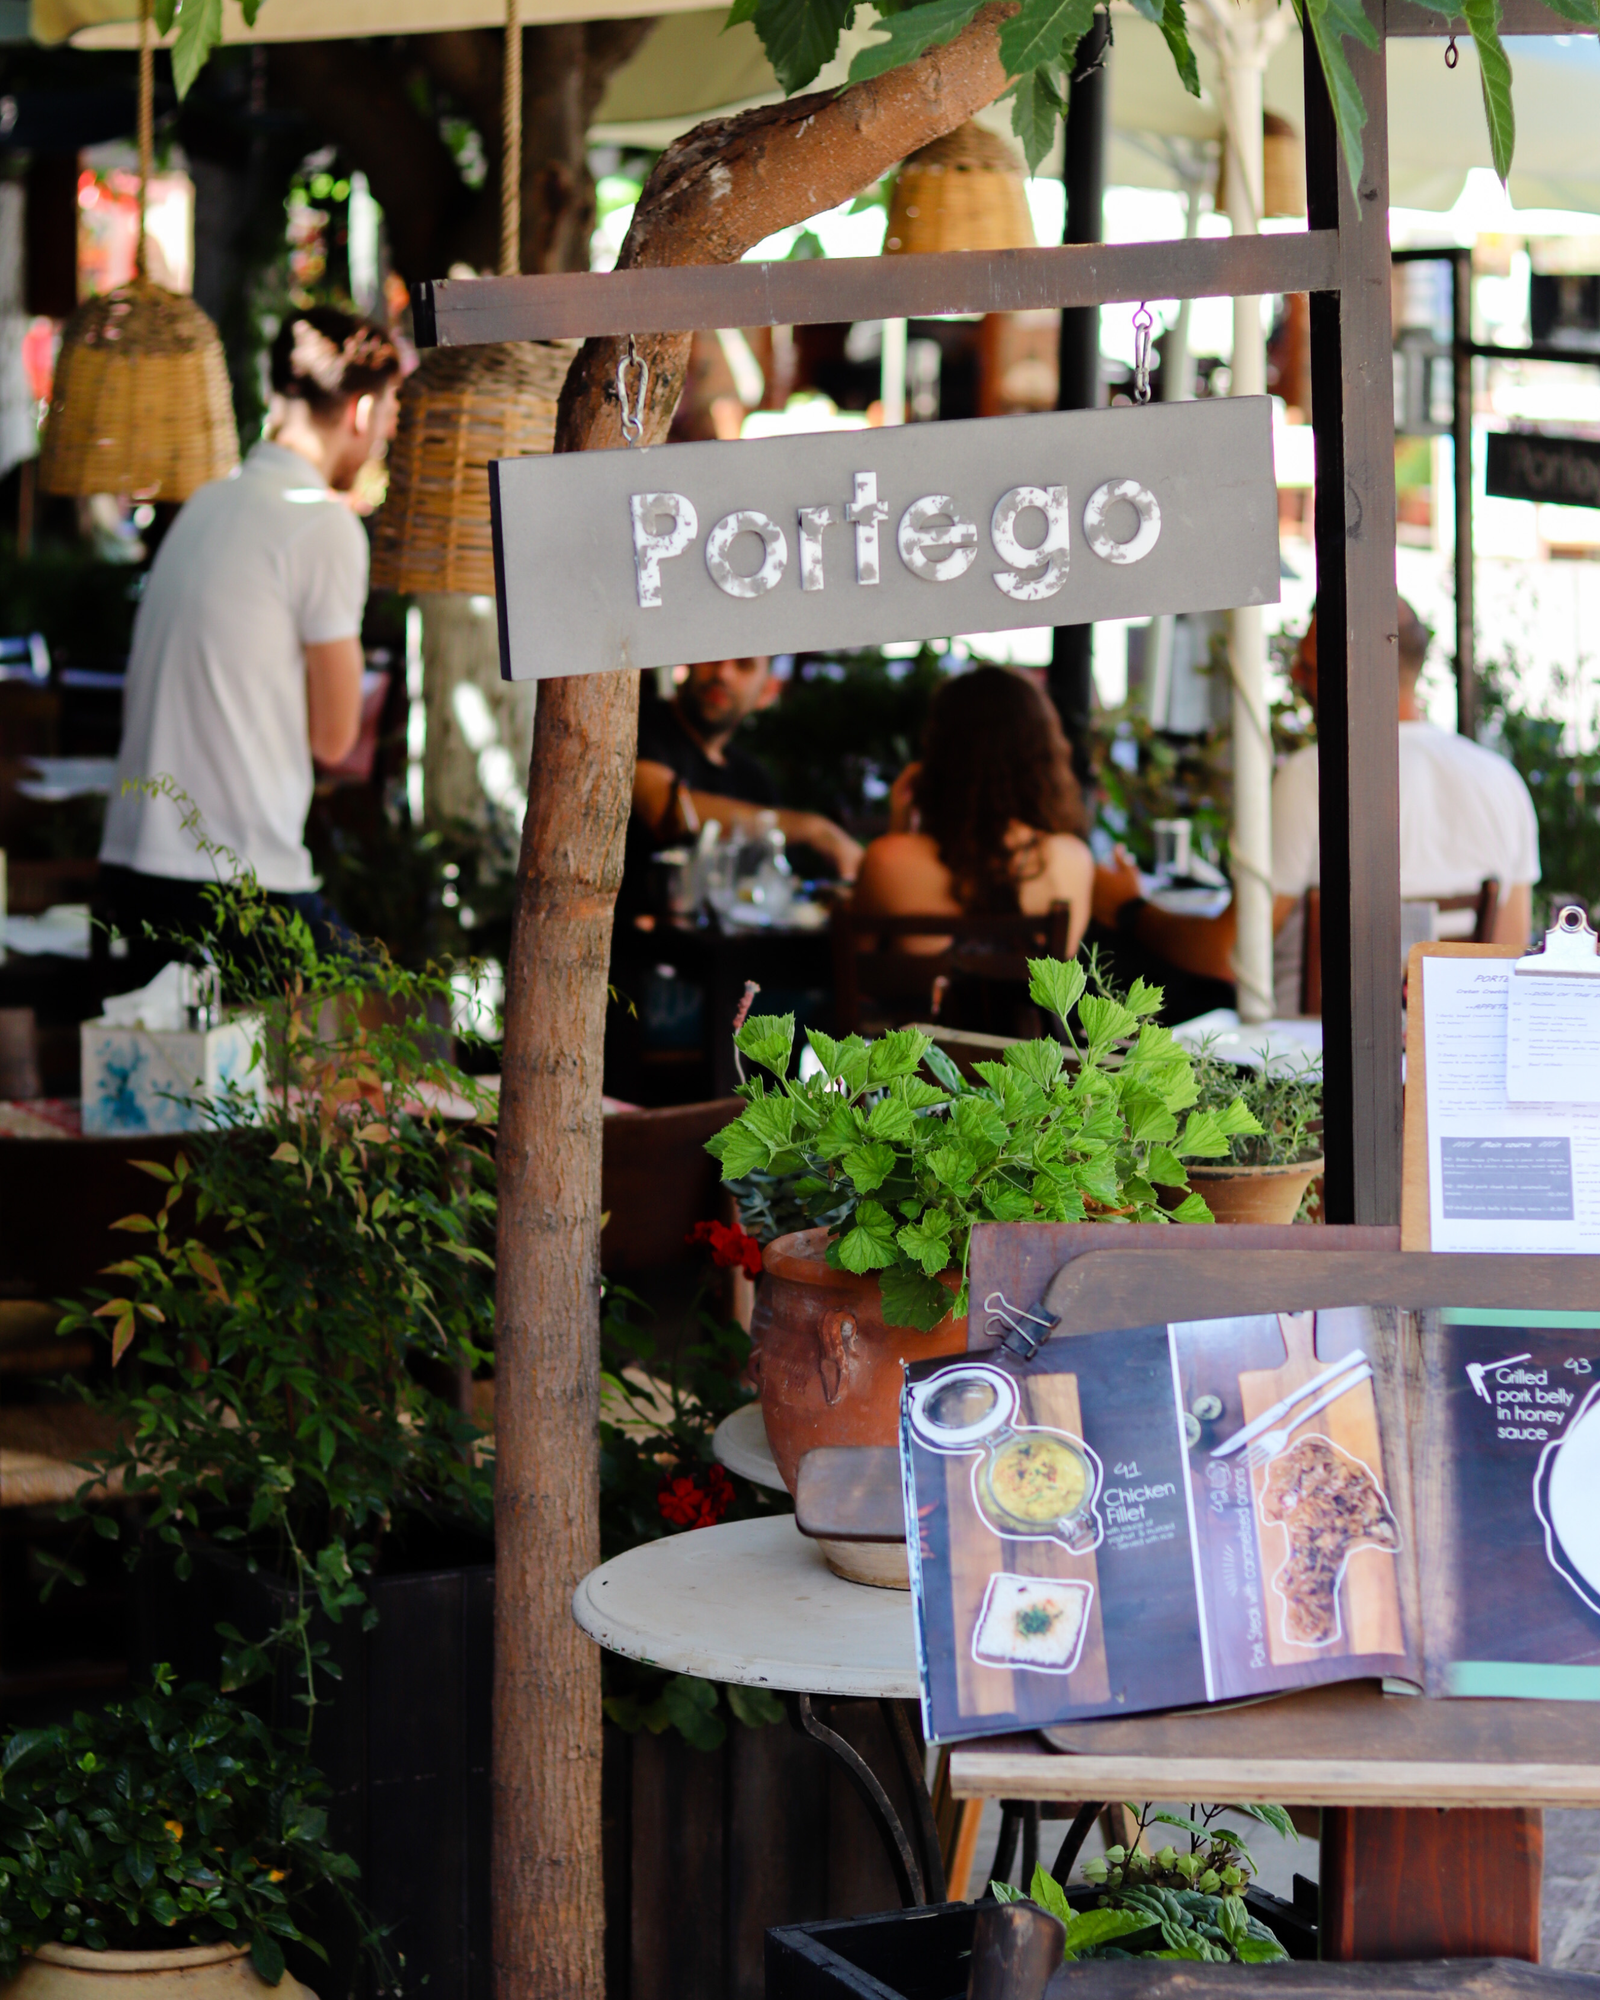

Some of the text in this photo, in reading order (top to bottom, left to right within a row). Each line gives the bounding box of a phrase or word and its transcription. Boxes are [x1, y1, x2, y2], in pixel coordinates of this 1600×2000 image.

[629, 470, 1162, 608] Portego
[1563, 1357, 1592, 1375] 43
[1495, 1367, 1548, 1386] Grilled
[1496, 1387, 1575, 1407] pork belly
[1496, 1404, 1566, 1425] in honey
[1497, 1426, 1549, 1441] sauce
[1113, 1460, 1142, 1479] 41
[1103, 1482, 1176, 1507] Chicken
[1106, 1503, 1145, 1526] Fillet
